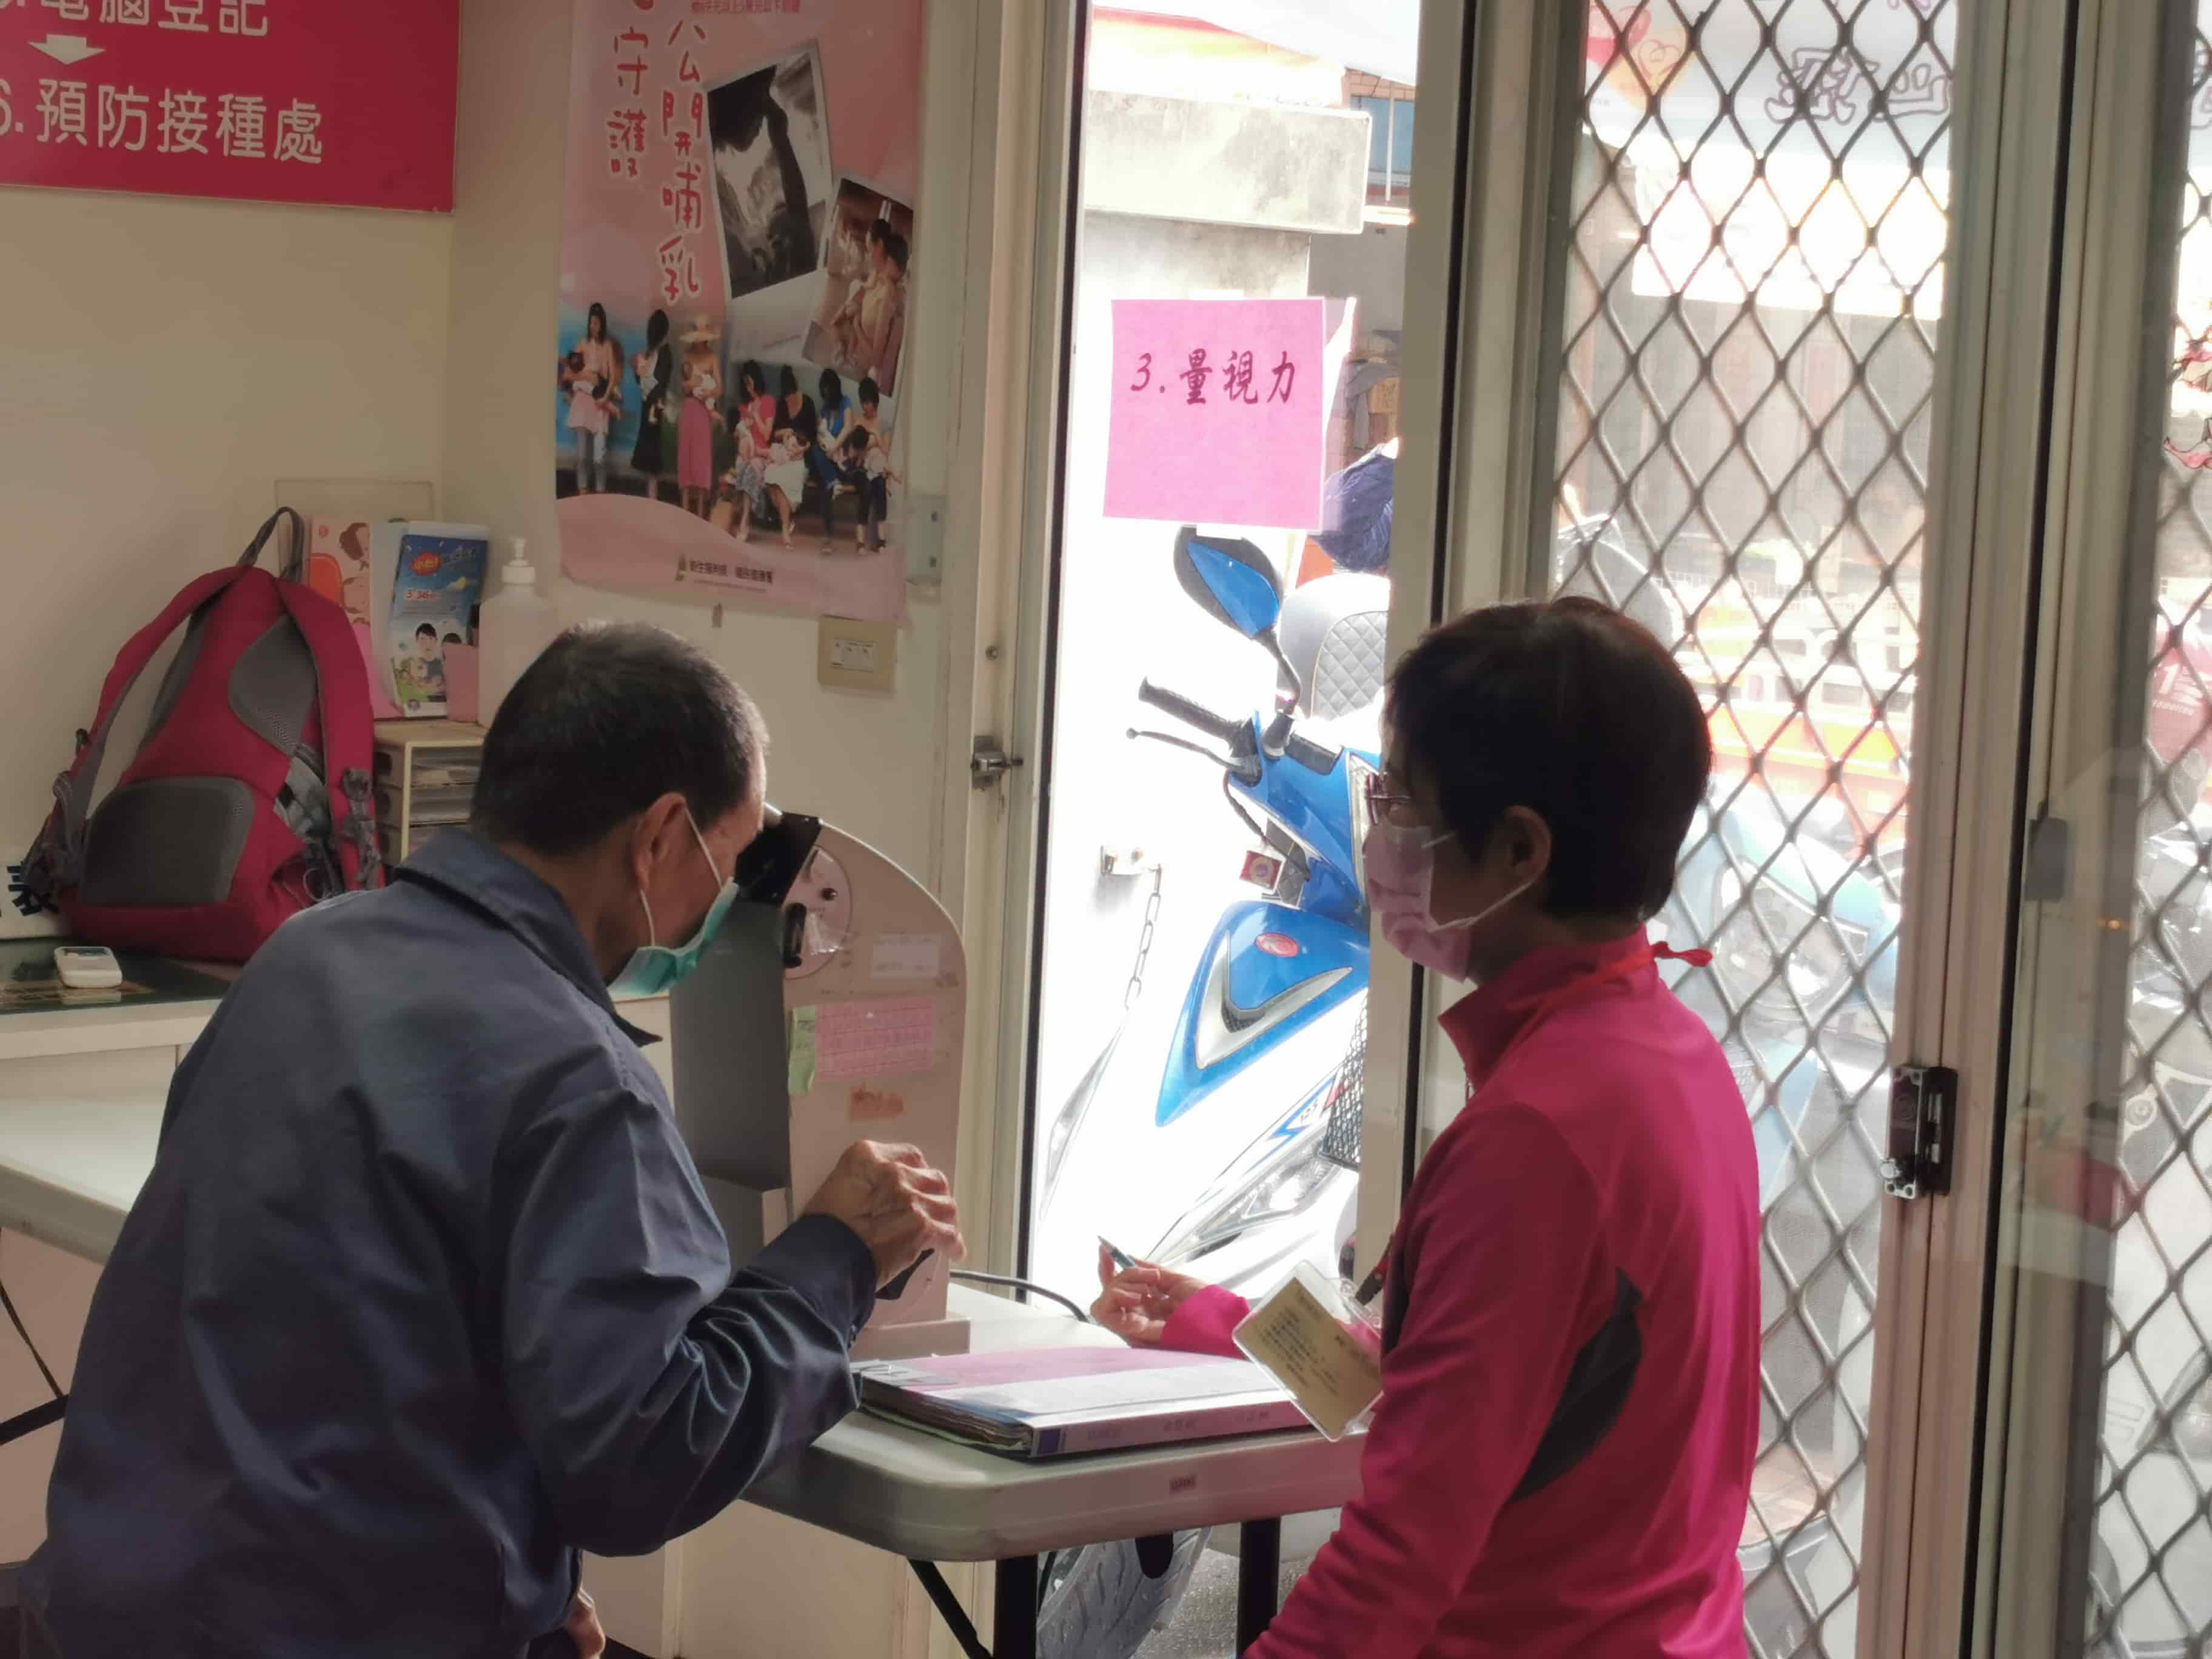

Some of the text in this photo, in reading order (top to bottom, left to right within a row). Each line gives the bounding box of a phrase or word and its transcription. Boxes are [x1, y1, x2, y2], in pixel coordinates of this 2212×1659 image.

[659, 19, 706, 301] 公開哺乳
[1130, 348, 1296, 405] 3.量視力
